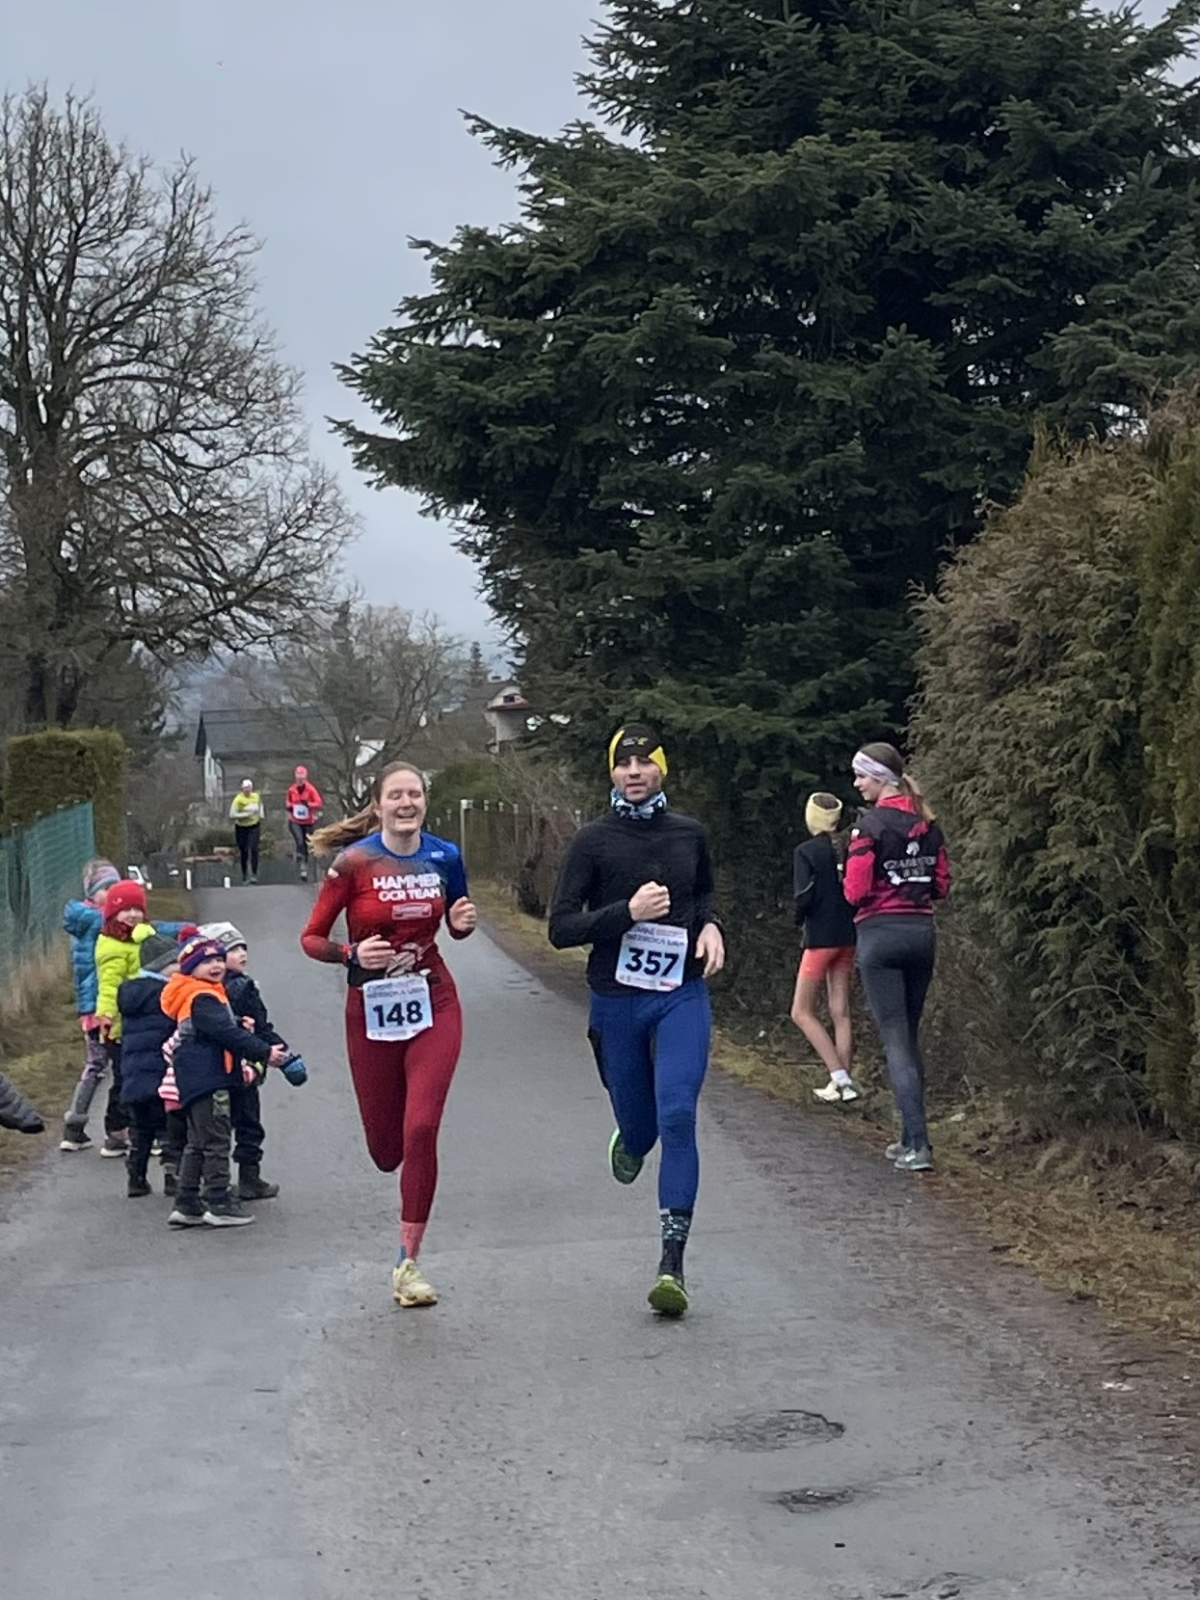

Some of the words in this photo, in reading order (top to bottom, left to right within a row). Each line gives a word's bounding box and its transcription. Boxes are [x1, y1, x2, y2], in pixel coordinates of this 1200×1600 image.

[372, 873, 441, 889] HAMMER
[378, 890, 406, 902] OCR
[407, 887, 441, 900] TEAM
[625, 948, 680, 976] 357
[373, 1000, 423, 1027] 148
